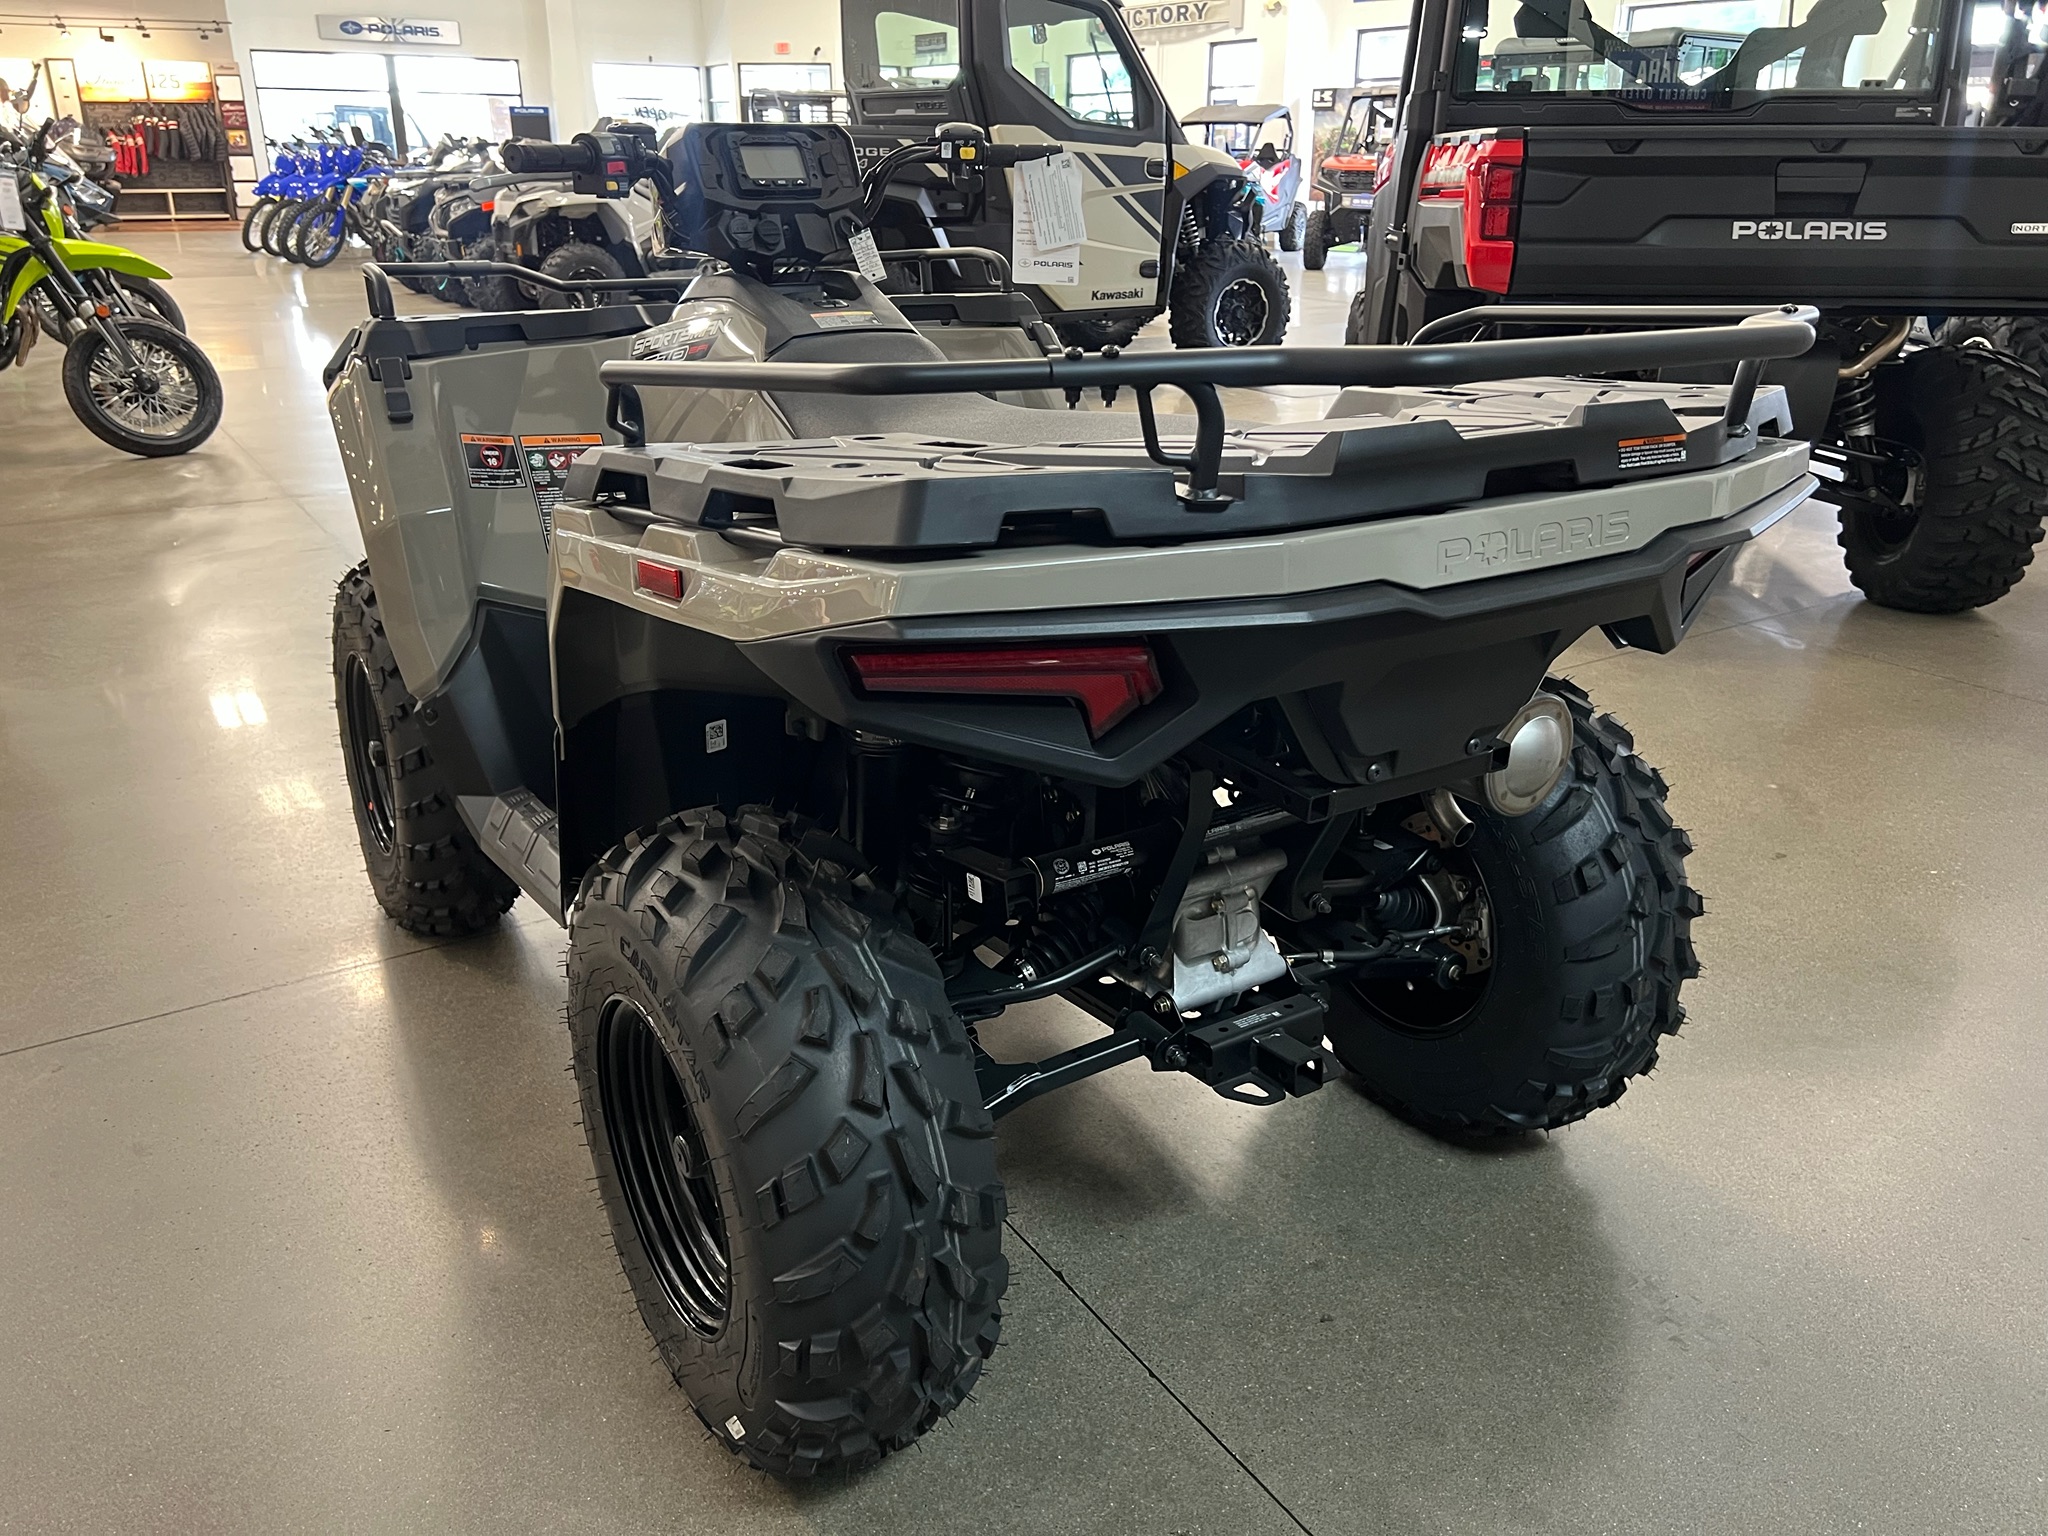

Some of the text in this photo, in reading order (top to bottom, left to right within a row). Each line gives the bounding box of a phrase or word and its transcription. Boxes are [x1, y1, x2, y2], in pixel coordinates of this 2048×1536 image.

[1126, 2, 1209, 26] ICTORY
[367, 23, 441, 37] POLARIS
[856, 147, 890, 157] DGE
[1732, 221, 1888, 240] POLARIS
[1033, 260, 1074, 269] POLARIS
[1091, 287, 1144, 301] Kawasaki
[487, 457, 498, 466] 16
[1436, 510, 1631, 576] POLARIS
